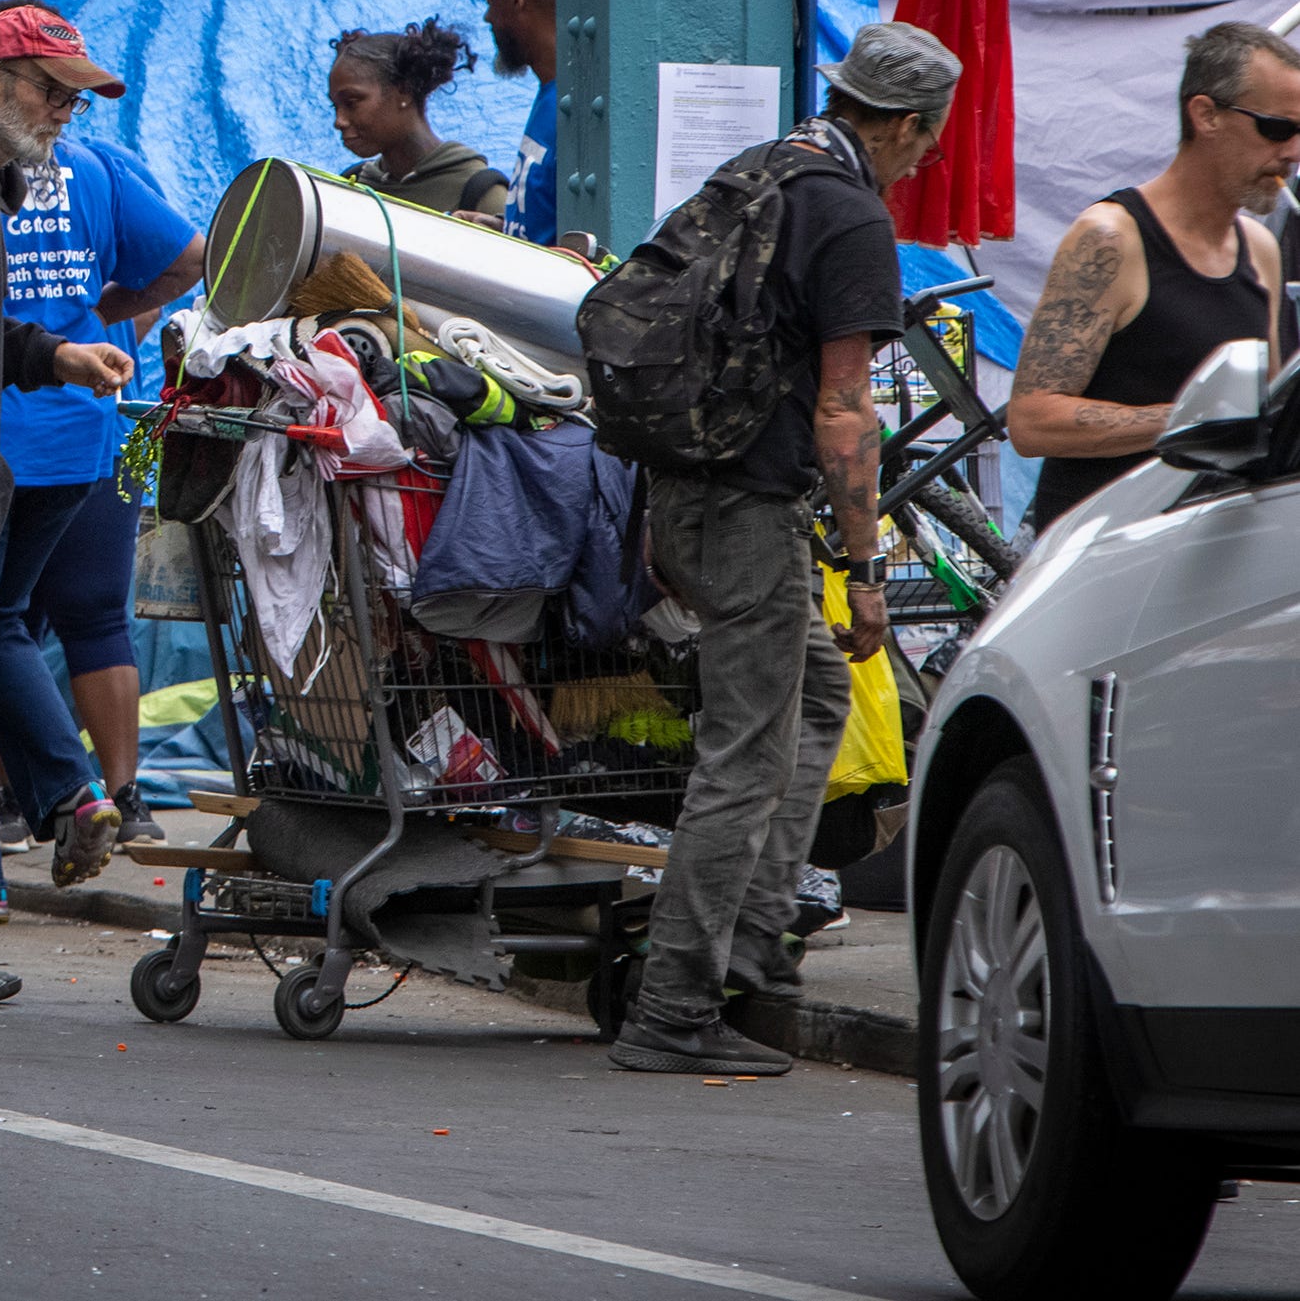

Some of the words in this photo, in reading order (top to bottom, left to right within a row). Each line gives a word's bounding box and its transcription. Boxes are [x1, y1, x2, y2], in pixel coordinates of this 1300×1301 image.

[6, 214, 72, 236] Ceters
[7, 251, 39, 265] here
[7, 267, 32, 283] ath
[10, 287, 23, 301] is
[25, 288, 35, 299] a
[38, 283, 63, 299] vlid
